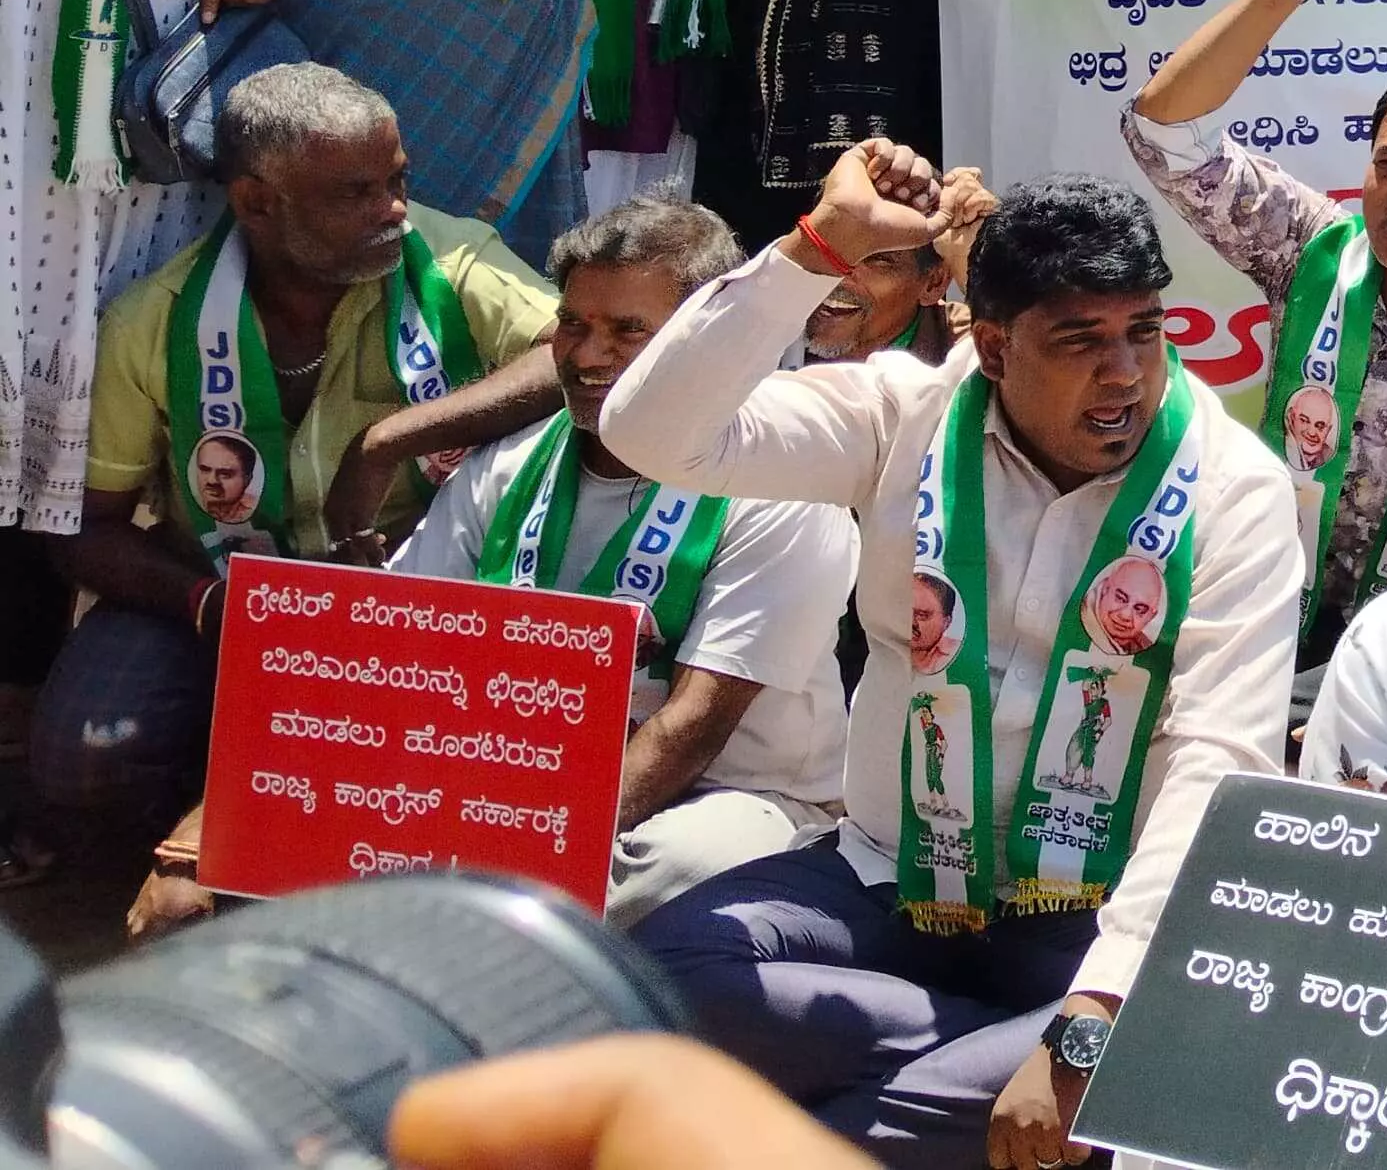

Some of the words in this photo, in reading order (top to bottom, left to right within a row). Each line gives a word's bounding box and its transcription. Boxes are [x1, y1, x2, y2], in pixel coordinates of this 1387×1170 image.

[246, 583, 335, 623] ಗ್ರೇಟರ್
[351, 597, 486, 638] ಬೆಂಗಳೂರು
[503, 615, 613, 668] ಹೆಸರಿನಲ್ಲಿ
[262, 646, 468, 711] ಬಿಬಿಎಂಪಿಯನ್ನು
[271, 708, 386, 748] ಮಾಡಲು
[405, 725, 564, 771] ಹೊರಟಿರುವ
[252, 770, 318, 814] ರಾಜ್ಯ
[334, 781, 442, 825] ಕಾಂಗ್ರೆಸ್
[460, 795, 569, 854] ಸರ್ಕಾರಕ್ಕೆ
[1254, 811, 1379, 857] ಹಾಲಿನ
[1210, 879, 1333, 925] ಮಾಡಲು
[1186, 950, 1275, 1013] ರಾಜ್ಯ
